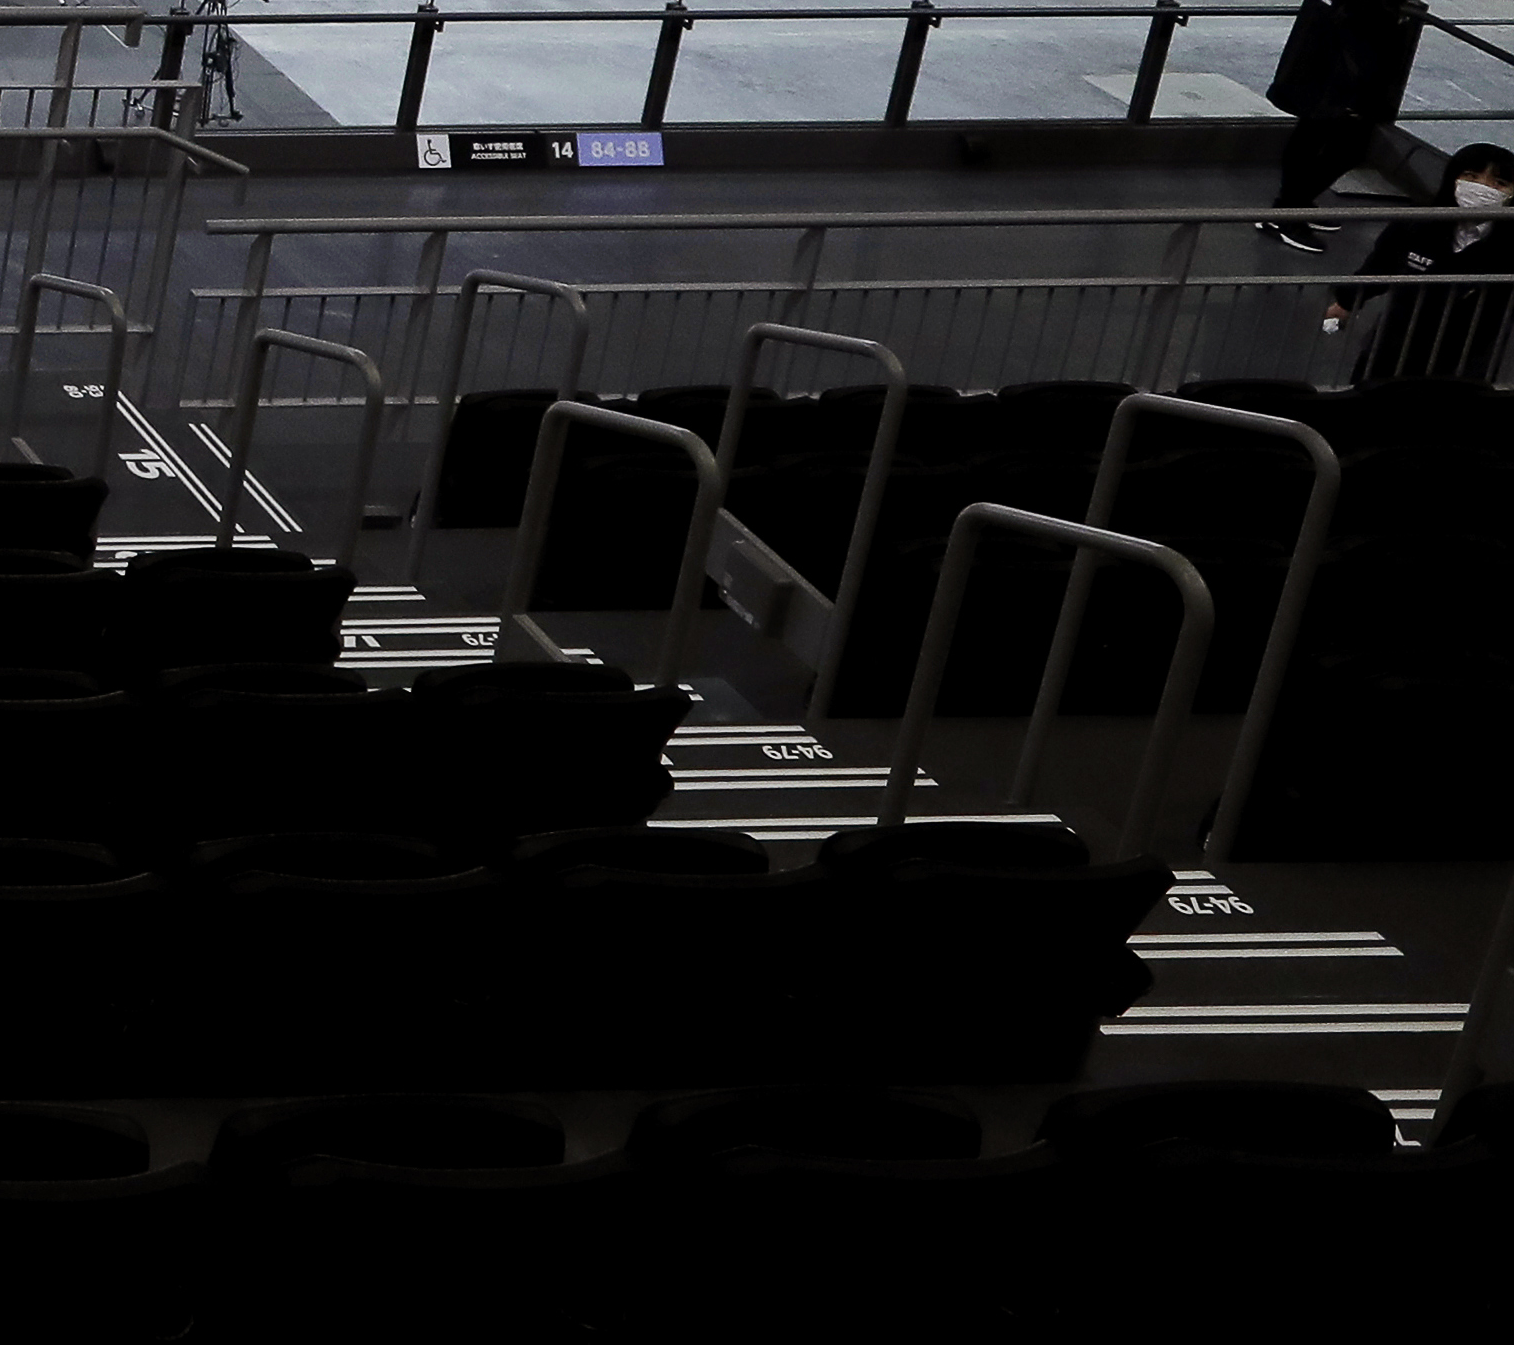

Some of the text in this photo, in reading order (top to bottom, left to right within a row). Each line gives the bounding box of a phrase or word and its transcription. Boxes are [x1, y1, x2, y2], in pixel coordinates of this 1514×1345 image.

[551, 140, 653, 160] 14 84-88
[117, 448, 176, 480] 15
[761, 745, 834, 760] 94-79
[1167, 896, 1255, 915] 94-79
